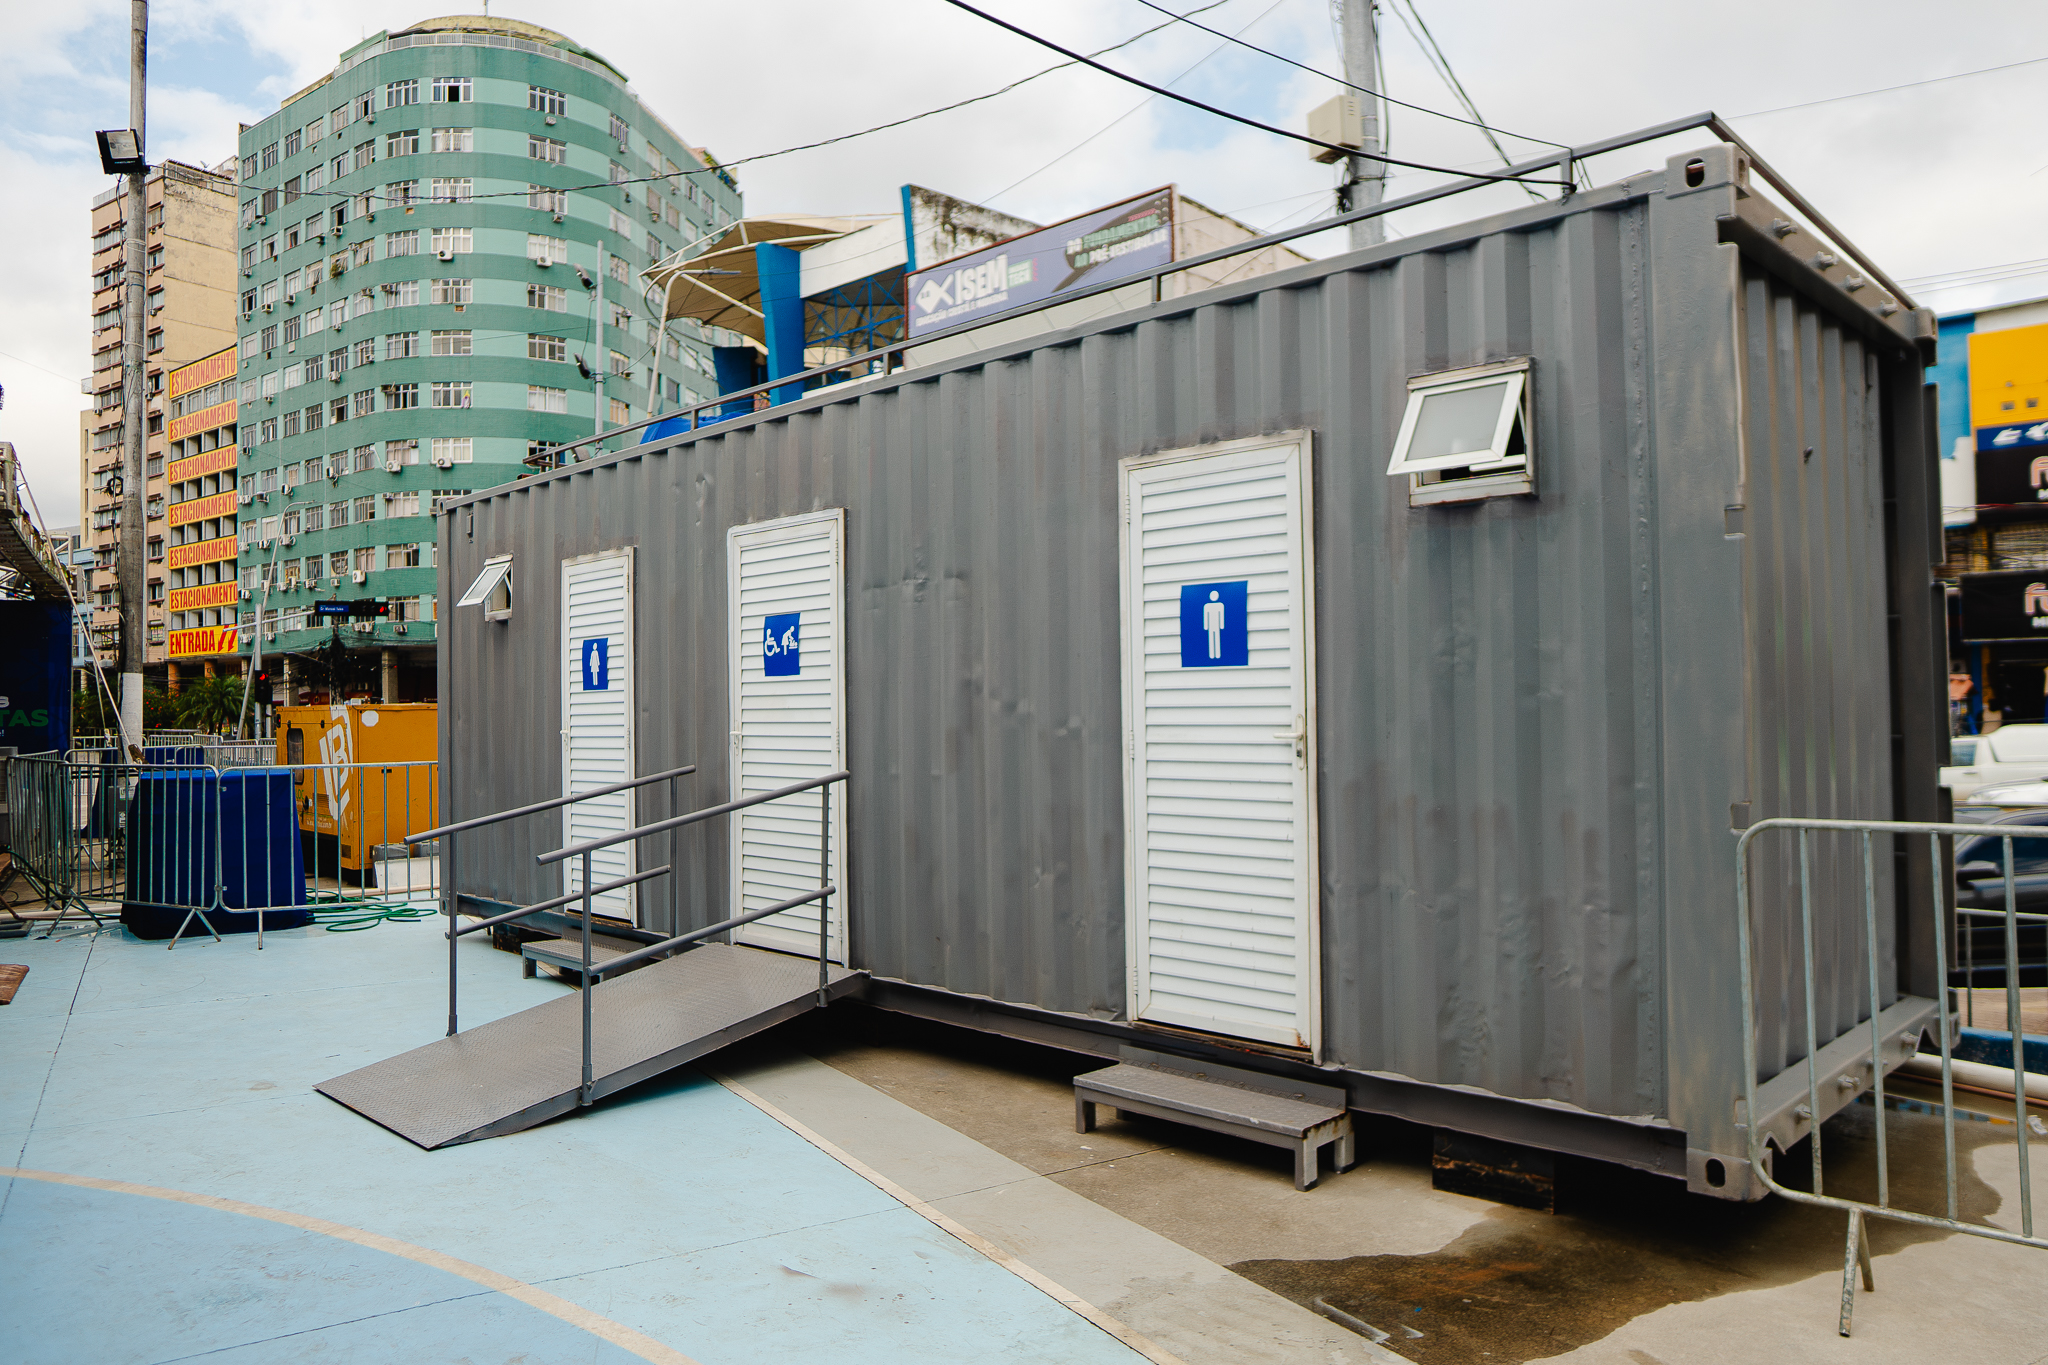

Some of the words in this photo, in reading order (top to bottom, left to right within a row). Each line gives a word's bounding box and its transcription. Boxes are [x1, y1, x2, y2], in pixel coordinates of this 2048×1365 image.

[954, 253, 1008, 305] ISEM
[171, 349, 236, 396] ESTACIONAMENTO
[170, 401, 236, 439] ESTACIONAMENTO
[170, 446, 236, 482] ESTACIONAMENTO
[170, 492, 237, 524] ESTACIONAMENTO
[170, 537, 237, 567] ESTACIONAMENTO
[171, 583, 237, 609] ESTACIONAMENTO
[170, 630, 215, 655] ENTRADA
